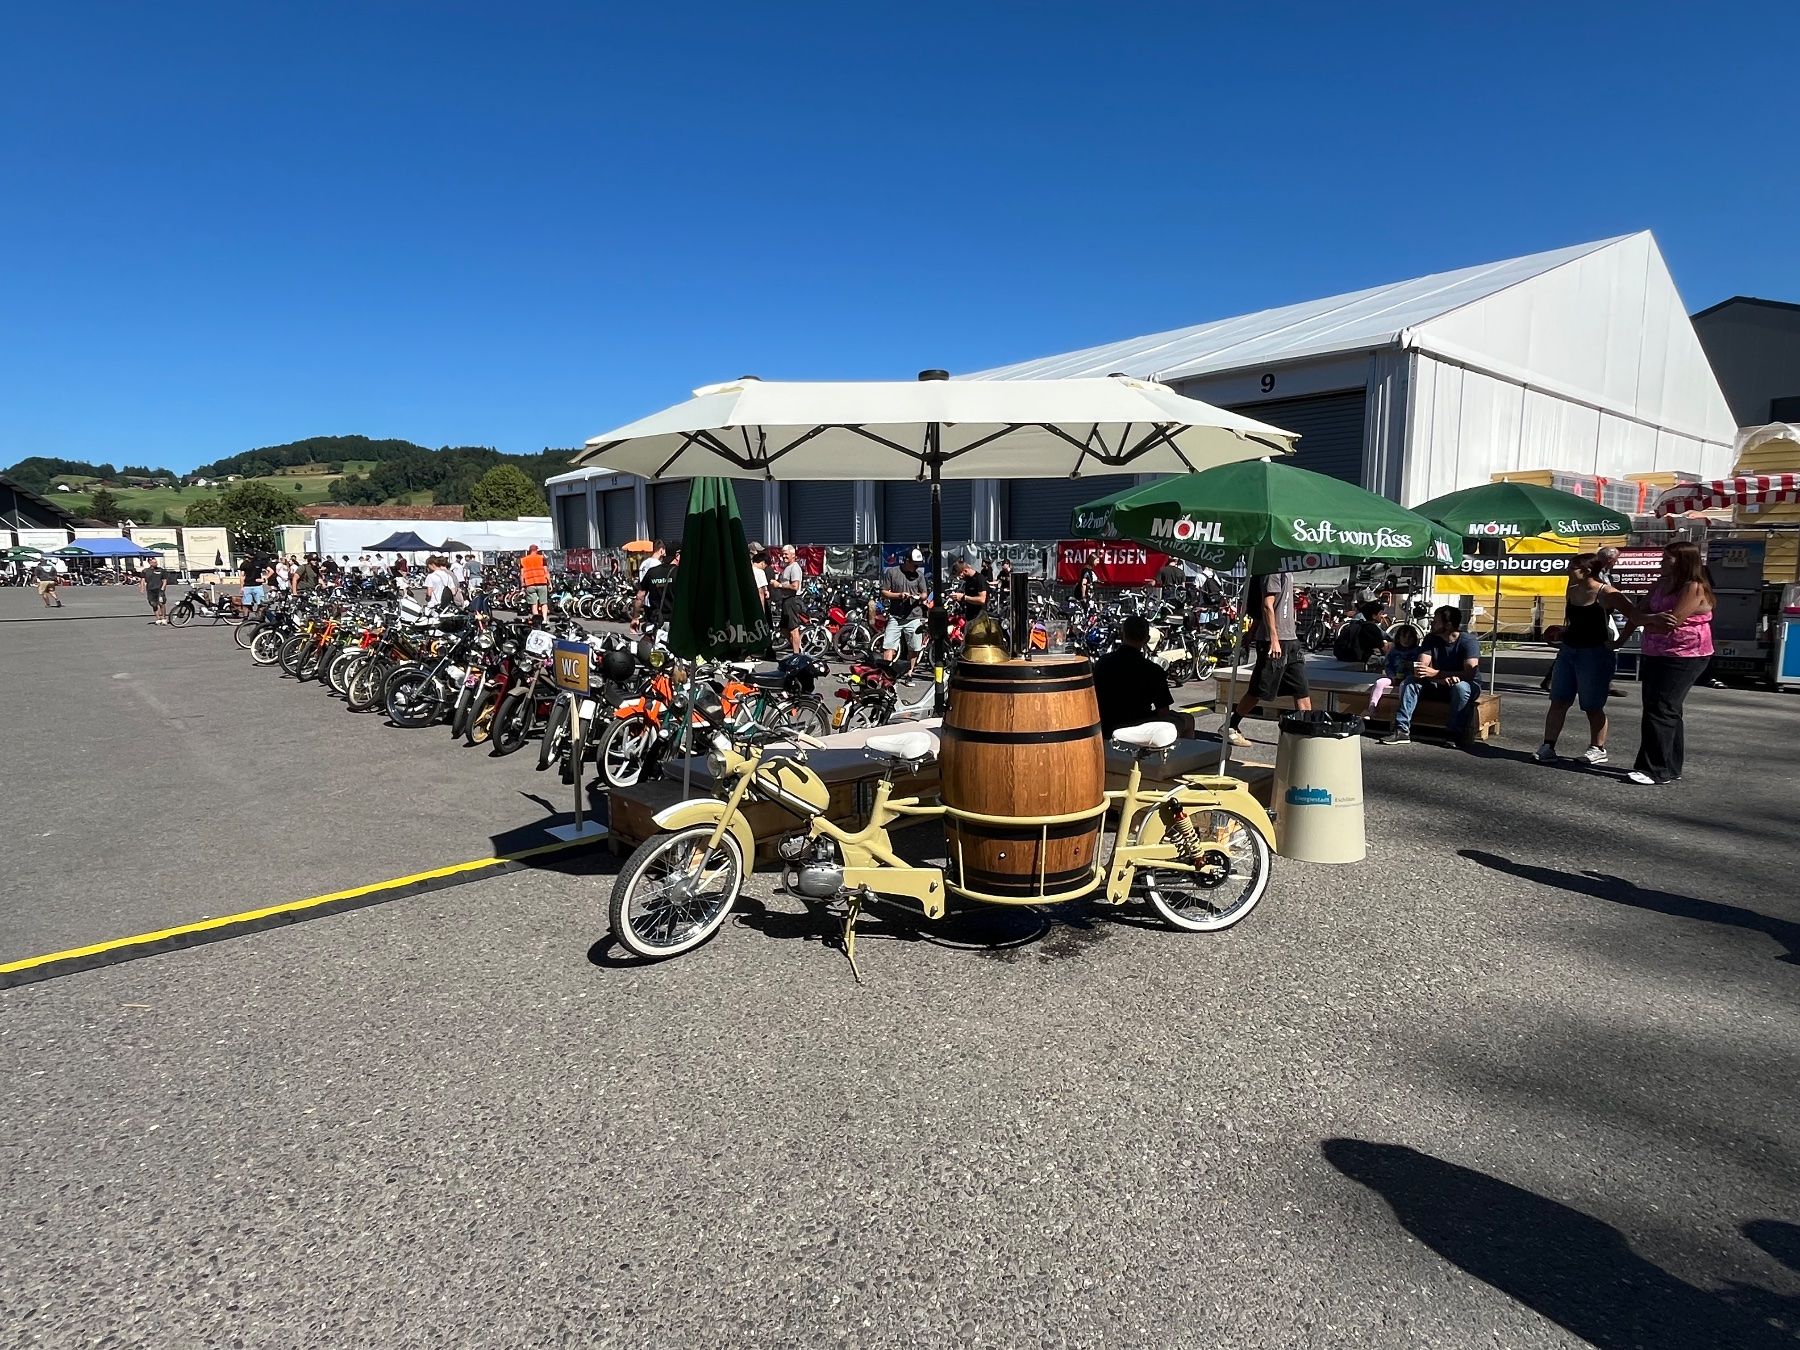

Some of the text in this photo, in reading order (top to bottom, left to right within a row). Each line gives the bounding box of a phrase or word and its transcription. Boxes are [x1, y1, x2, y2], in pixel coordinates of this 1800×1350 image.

[1261, 373, 1275, 393] 9
[1292, 519, 1337, 545] Saft
[1337, 530, 1375, 547] vom
[1557, 519, 1581, 533] Saft
[1443, 556, 1571, 573] ggenburger
[561, 657, 580, 679] WC
